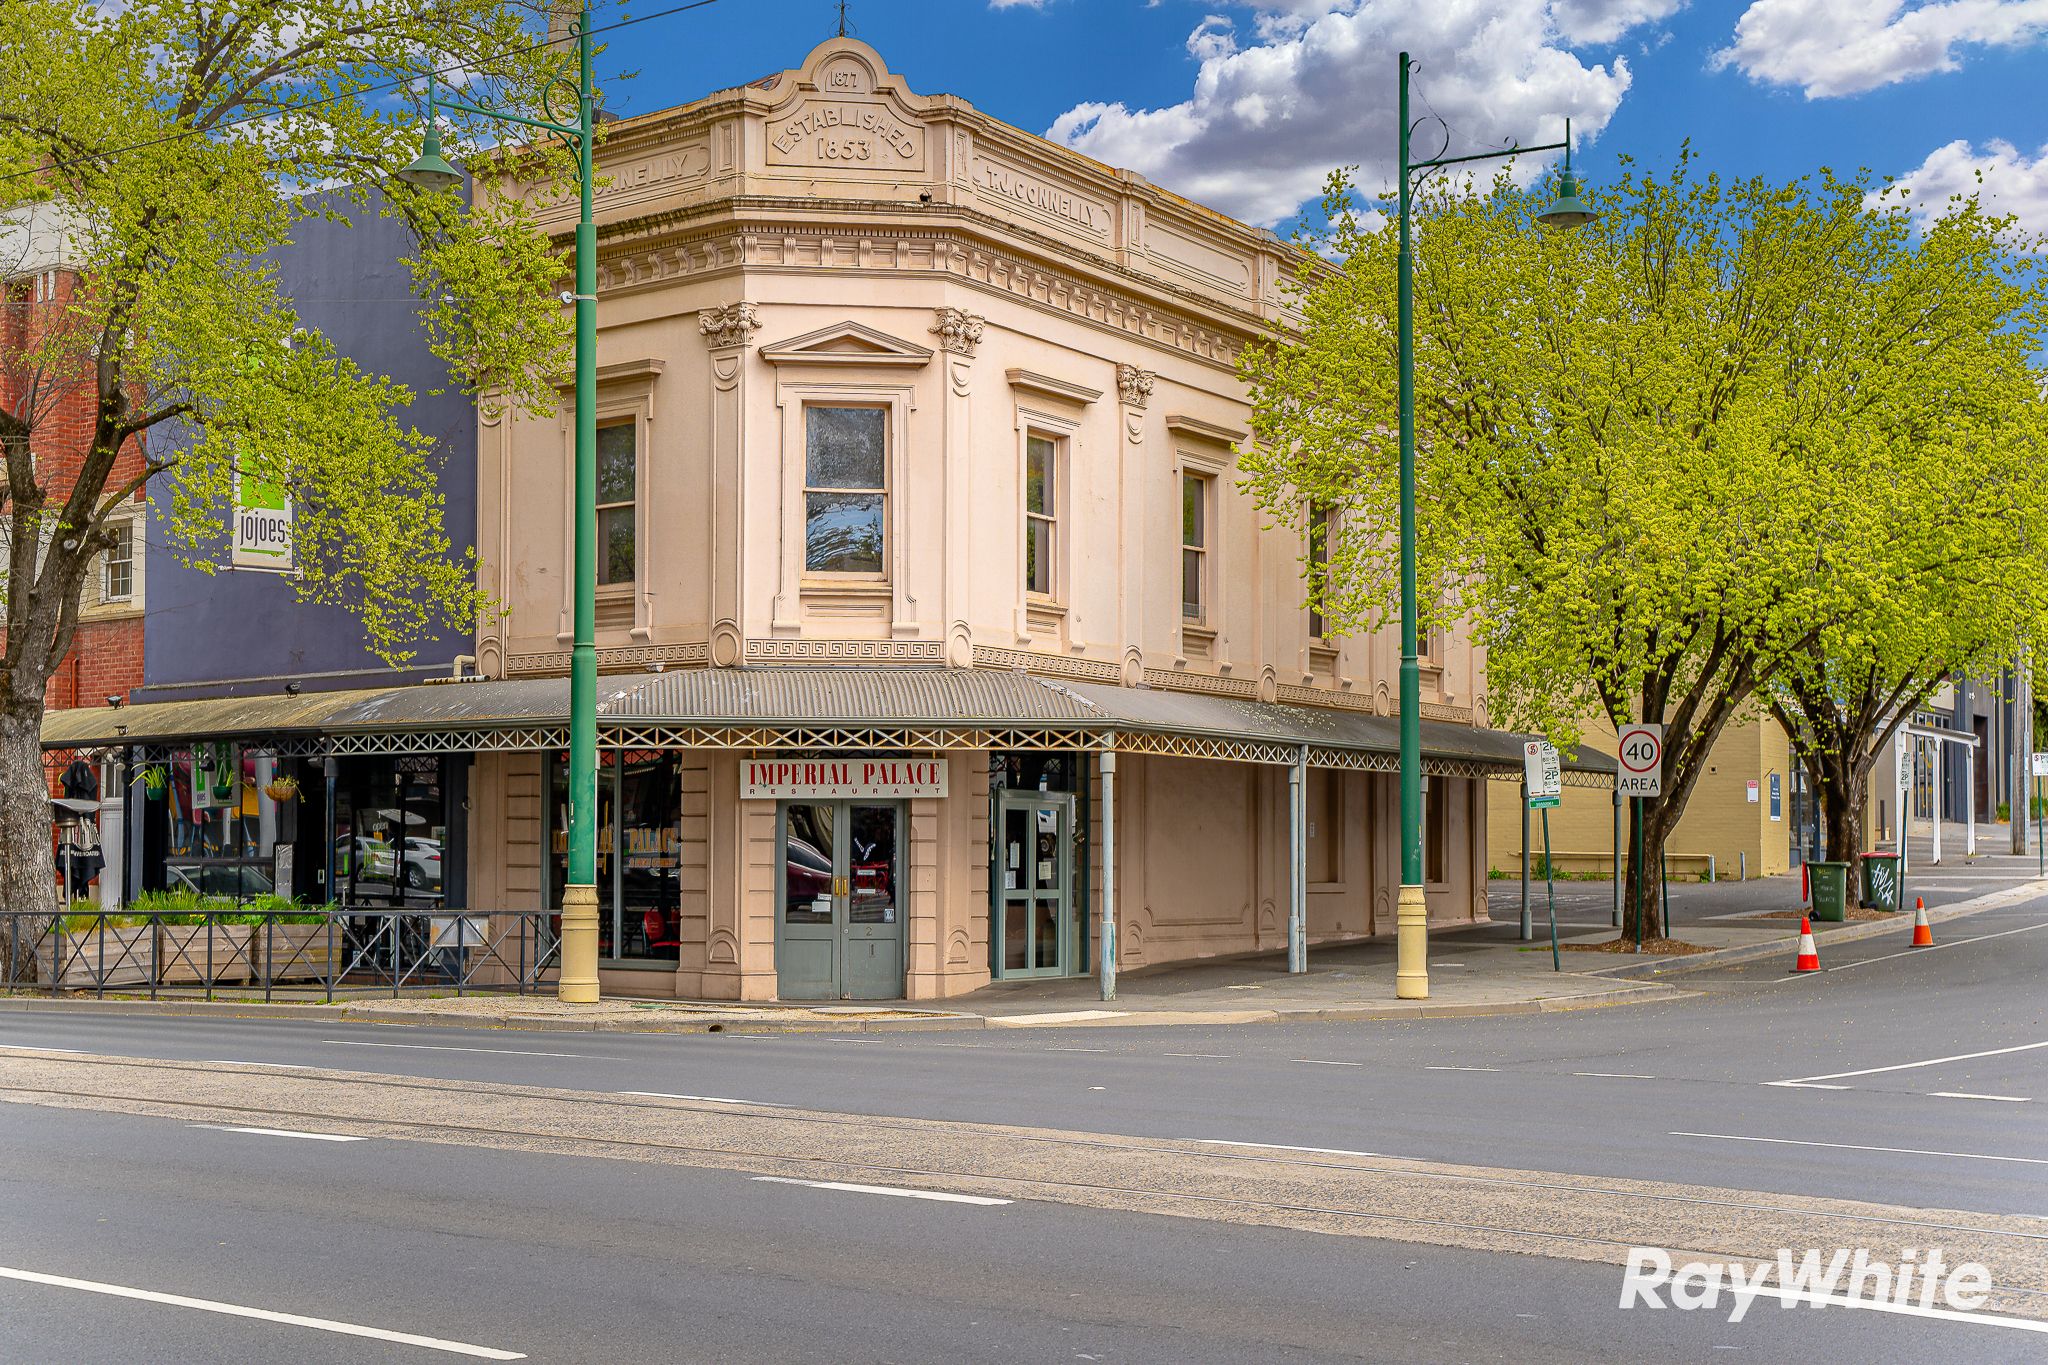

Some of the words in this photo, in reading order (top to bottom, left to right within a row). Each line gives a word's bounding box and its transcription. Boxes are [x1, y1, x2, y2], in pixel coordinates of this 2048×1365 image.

[830, 70, 858, 88] 1877
[772, 107, 916, 159] ESTABLISHED
[818, 138, 872, 160] 1853
[240, 509, 286, 546] jojoes
[1625, 742, 1654, 761] 40
[749, 763, 853, 785] IMPERIAL
[863, 763, 941, 785] PALACE
[1544, 771, 1559, 780] 2P
[1619, 778, 1659, 791] AREA
